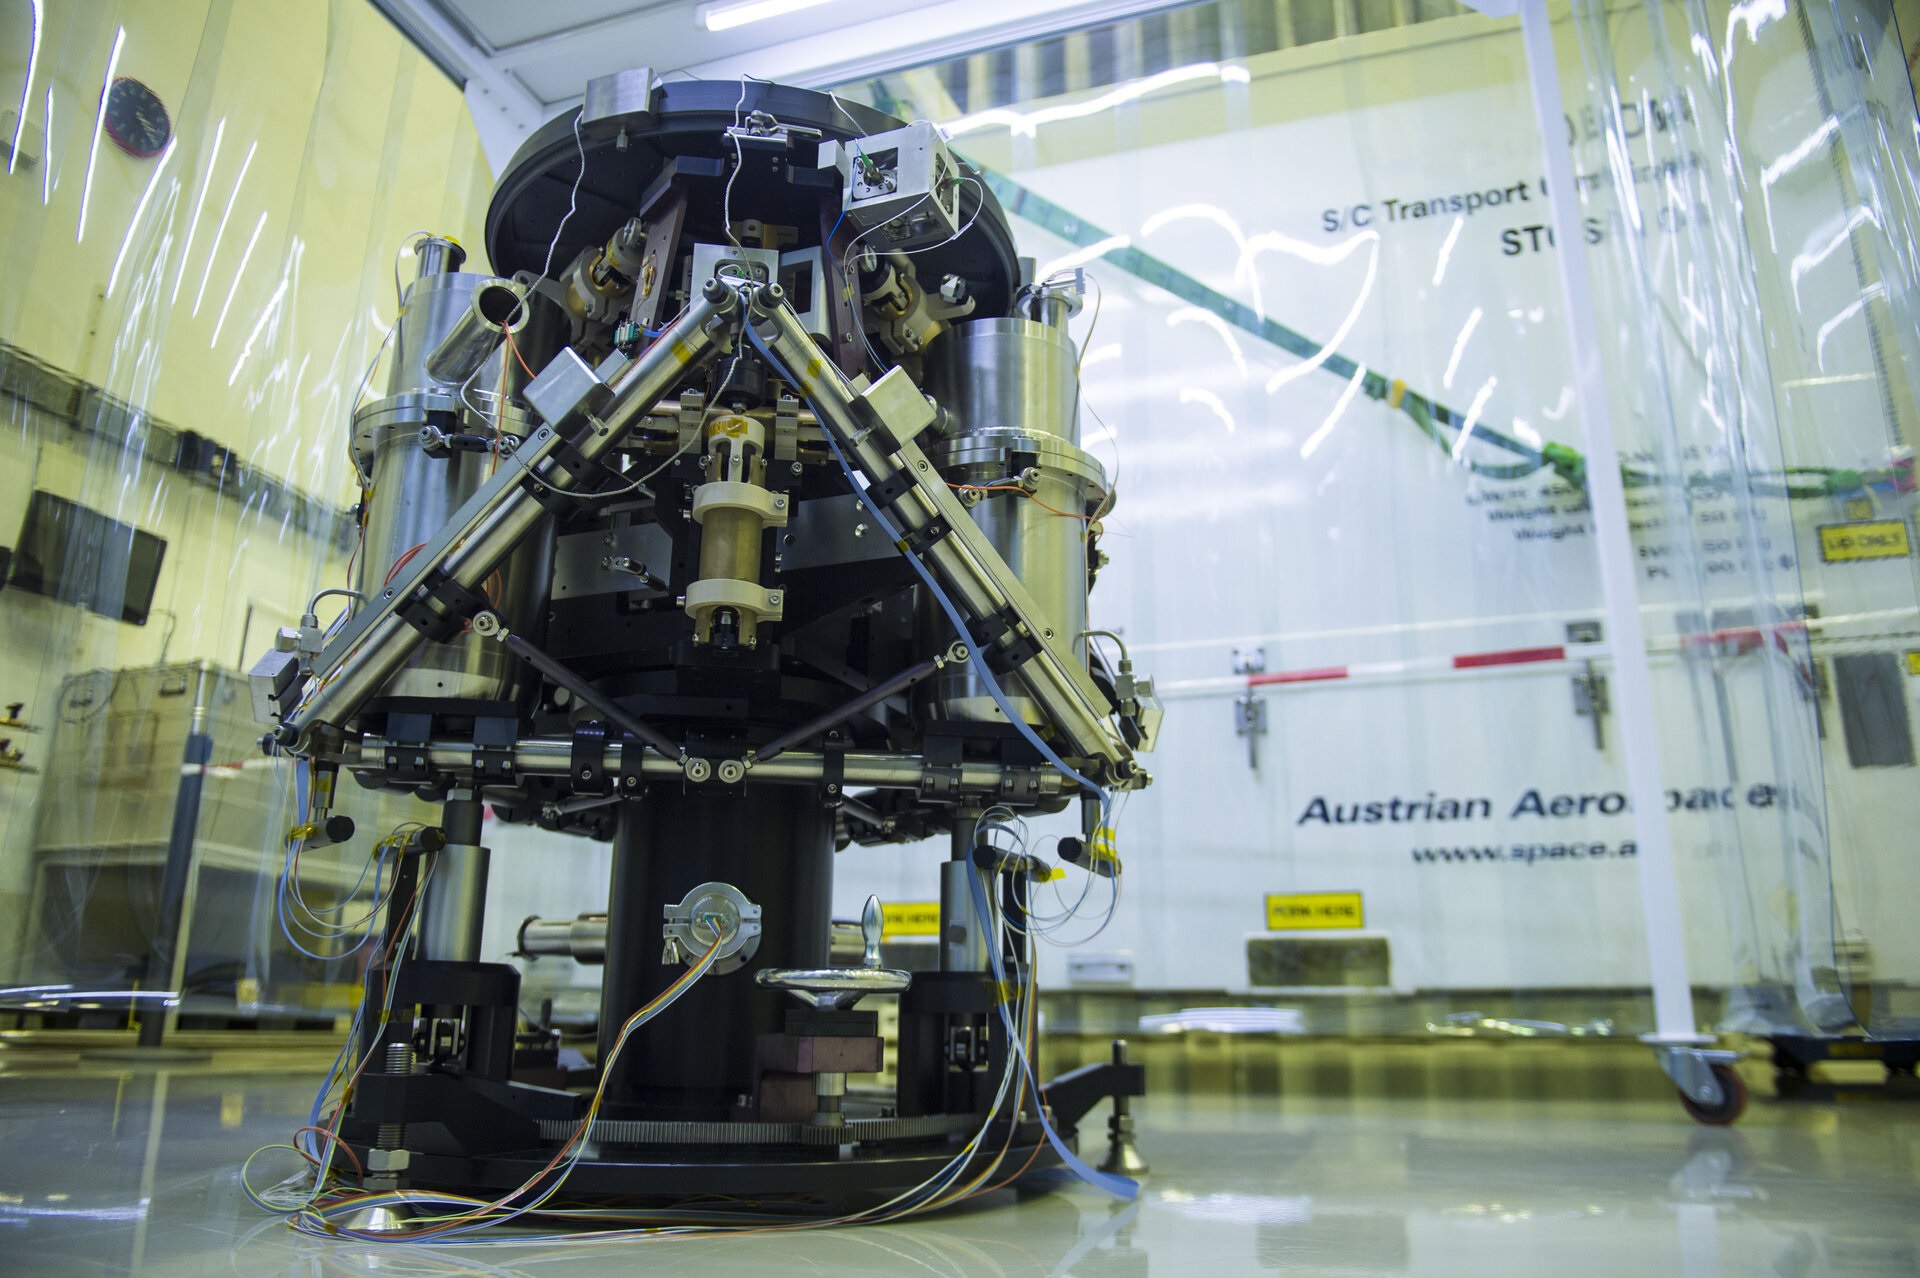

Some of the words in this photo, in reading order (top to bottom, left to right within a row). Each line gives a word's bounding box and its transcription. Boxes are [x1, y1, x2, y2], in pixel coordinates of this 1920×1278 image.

[1322, 203, 1374, 233] S/C
[1383, 179, 1531, 223] Transport
[1296, 790, 1492, 826] Austrian
[1411, 839, 1638, 867] www.space.a
